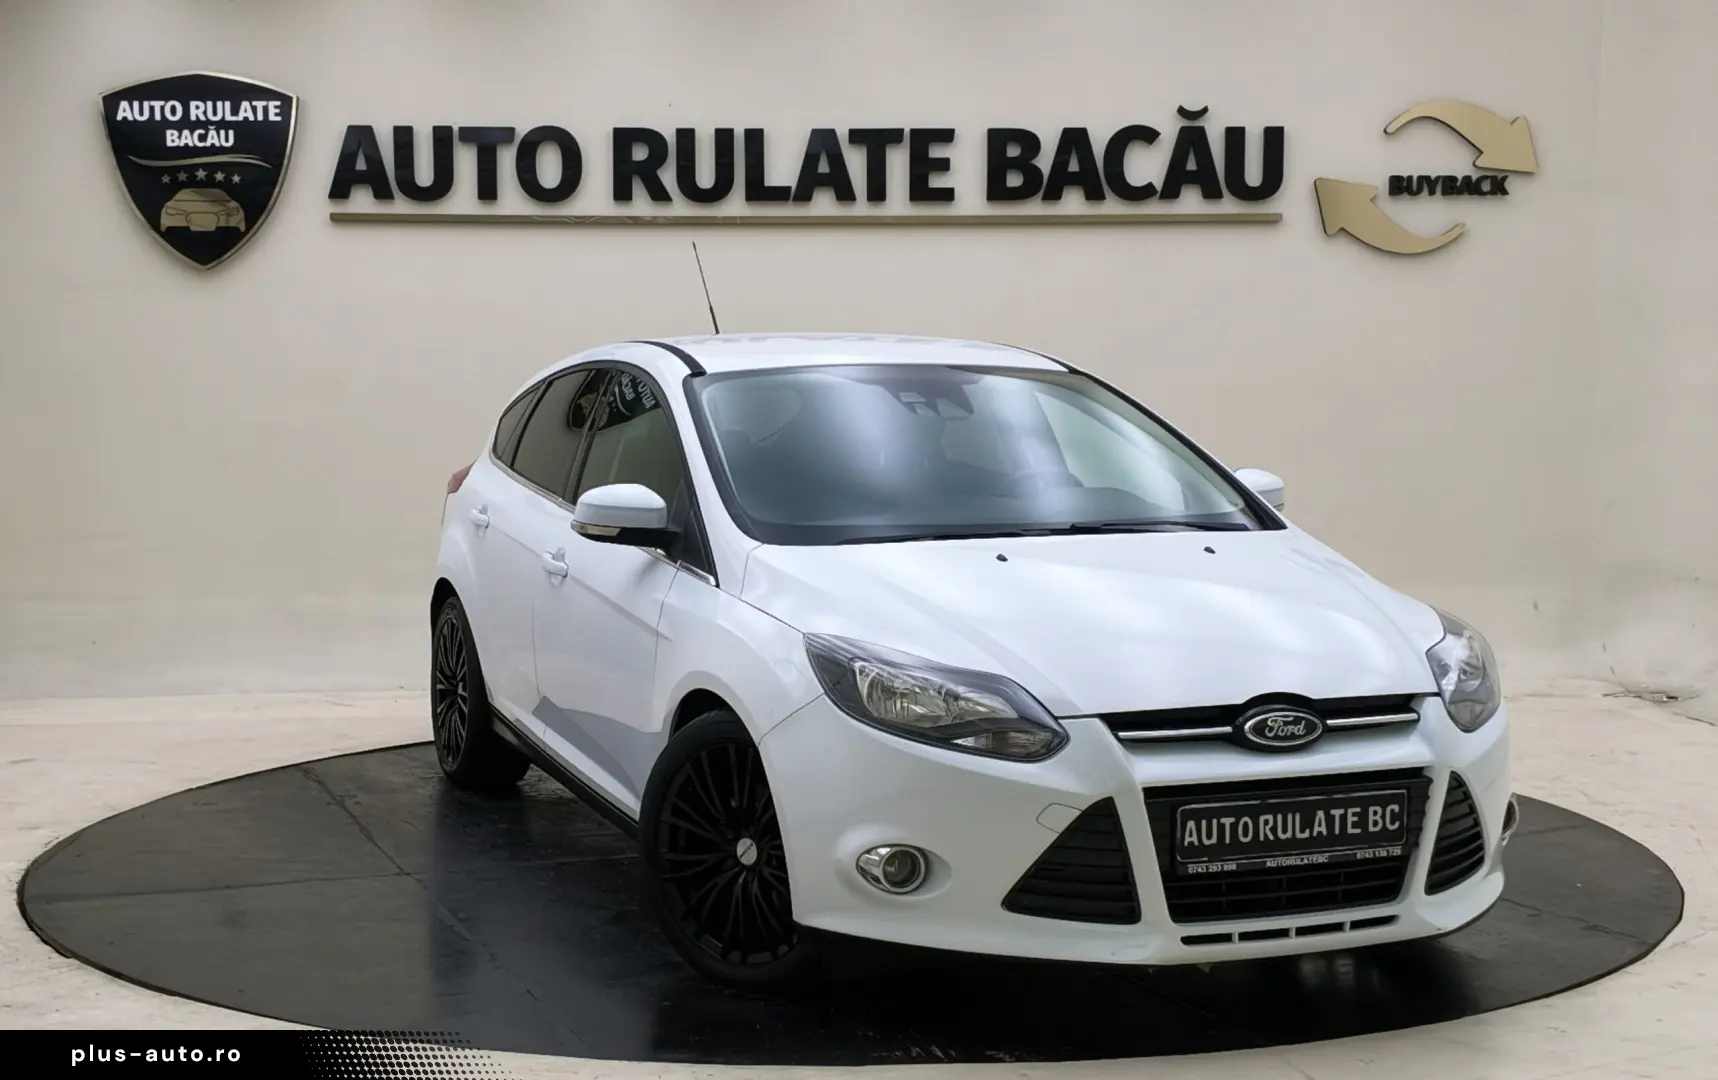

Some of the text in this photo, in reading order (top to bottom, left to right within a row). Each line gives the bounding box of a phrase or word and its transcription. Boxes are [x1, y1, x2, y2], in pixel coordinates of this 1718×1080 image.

[116, 100, 282, 121] AUTO RULATE
[165, 125, 234, 147] BACĂU
[328, 105, 1285, 202] AUTO RULATE BACĂU
[1388, 175, 1510, 196] BUYBACK
[1264, 716, 1307, 737] Ford
[1183, 804, 1400, 847] AUTO RULATE BC
